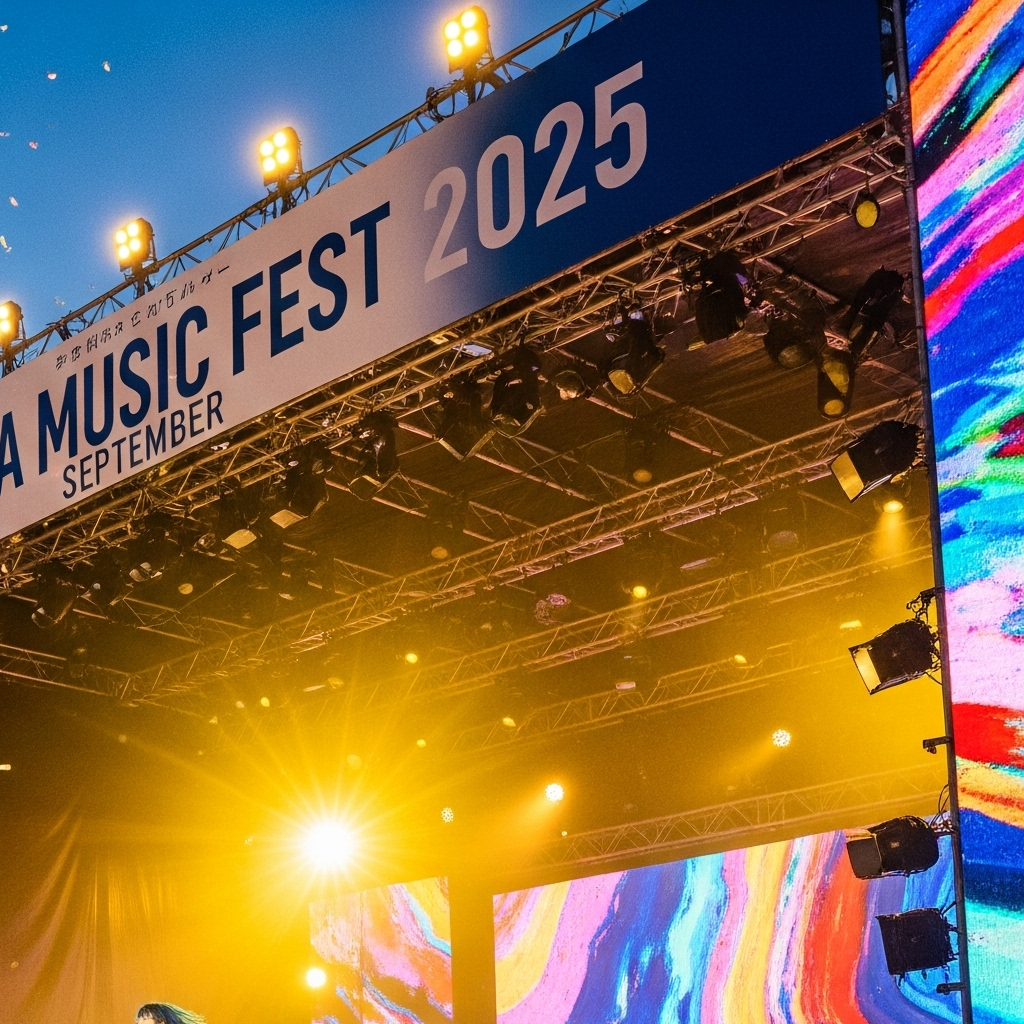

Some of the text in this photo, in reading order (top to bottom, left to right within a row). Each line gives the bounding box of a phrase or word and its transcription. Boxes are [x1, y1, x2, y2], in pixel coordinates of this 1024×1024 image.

[38, 305, 210, 476] MUSIC
[232, 201, 391, 377] FEST
[424, 61, 648, 284] 2025
[63, 390, 225, 500] SEPTEMBER
